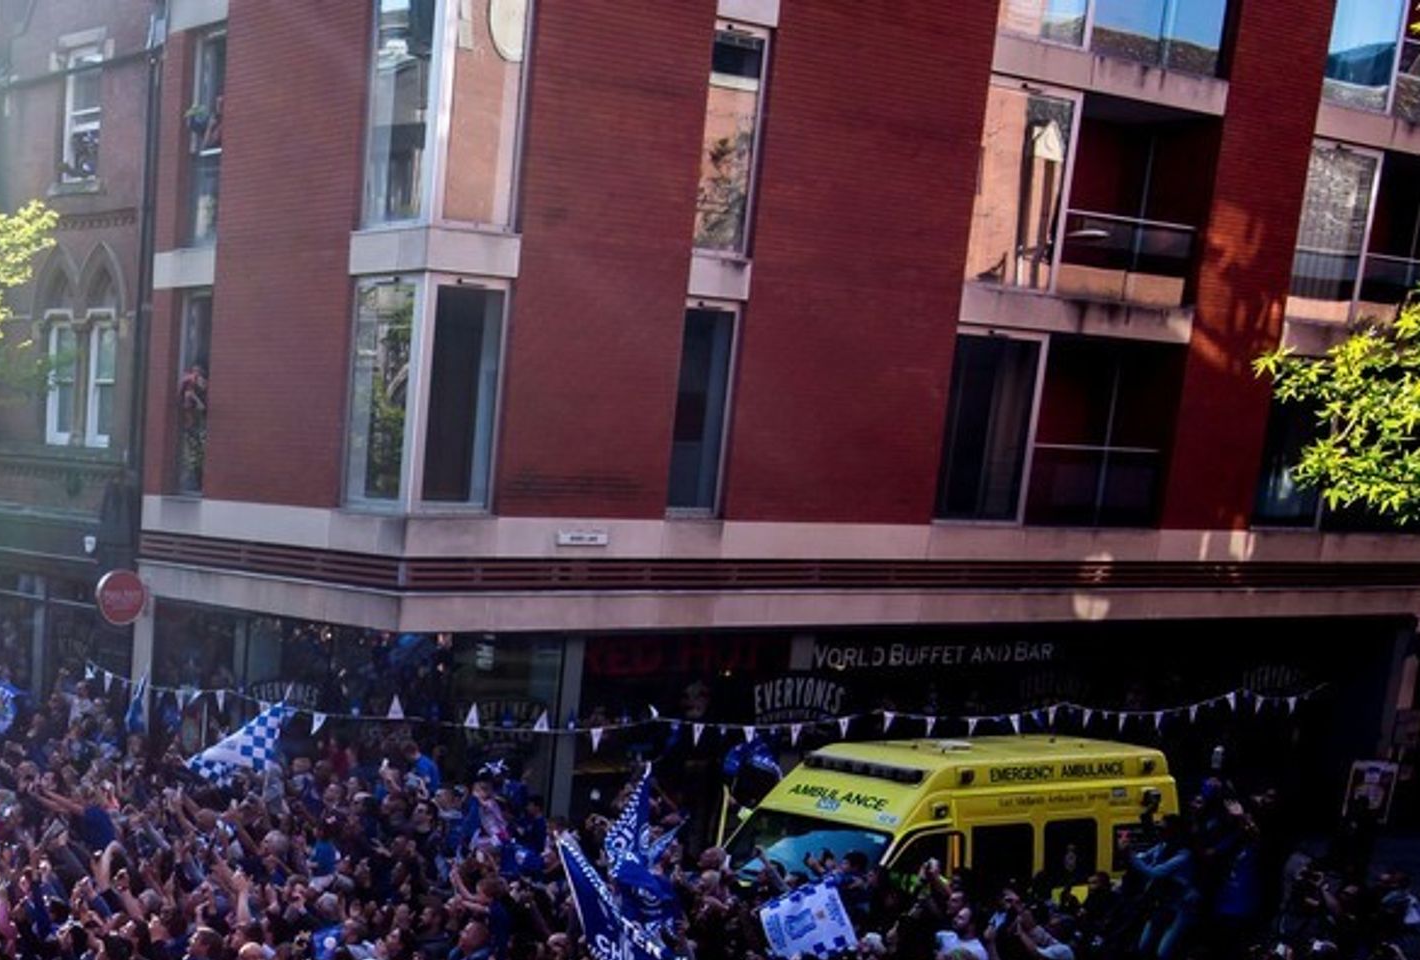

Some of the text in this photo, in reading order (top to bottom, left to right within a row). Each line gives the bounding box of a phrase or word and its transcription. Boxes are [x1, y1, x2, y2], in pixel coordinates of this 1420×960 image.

[887, 642, 966, 667] BUFFET
[969, 643, 1012, 665] AND
[1013, 640, 1055, 662] BAR
[754, 676, 846, 715] EVERYONES
[989, 760, 1125, 783] EMERGENCY AMBULANCE
[788, 783, 889, 811] AMBULANCE
